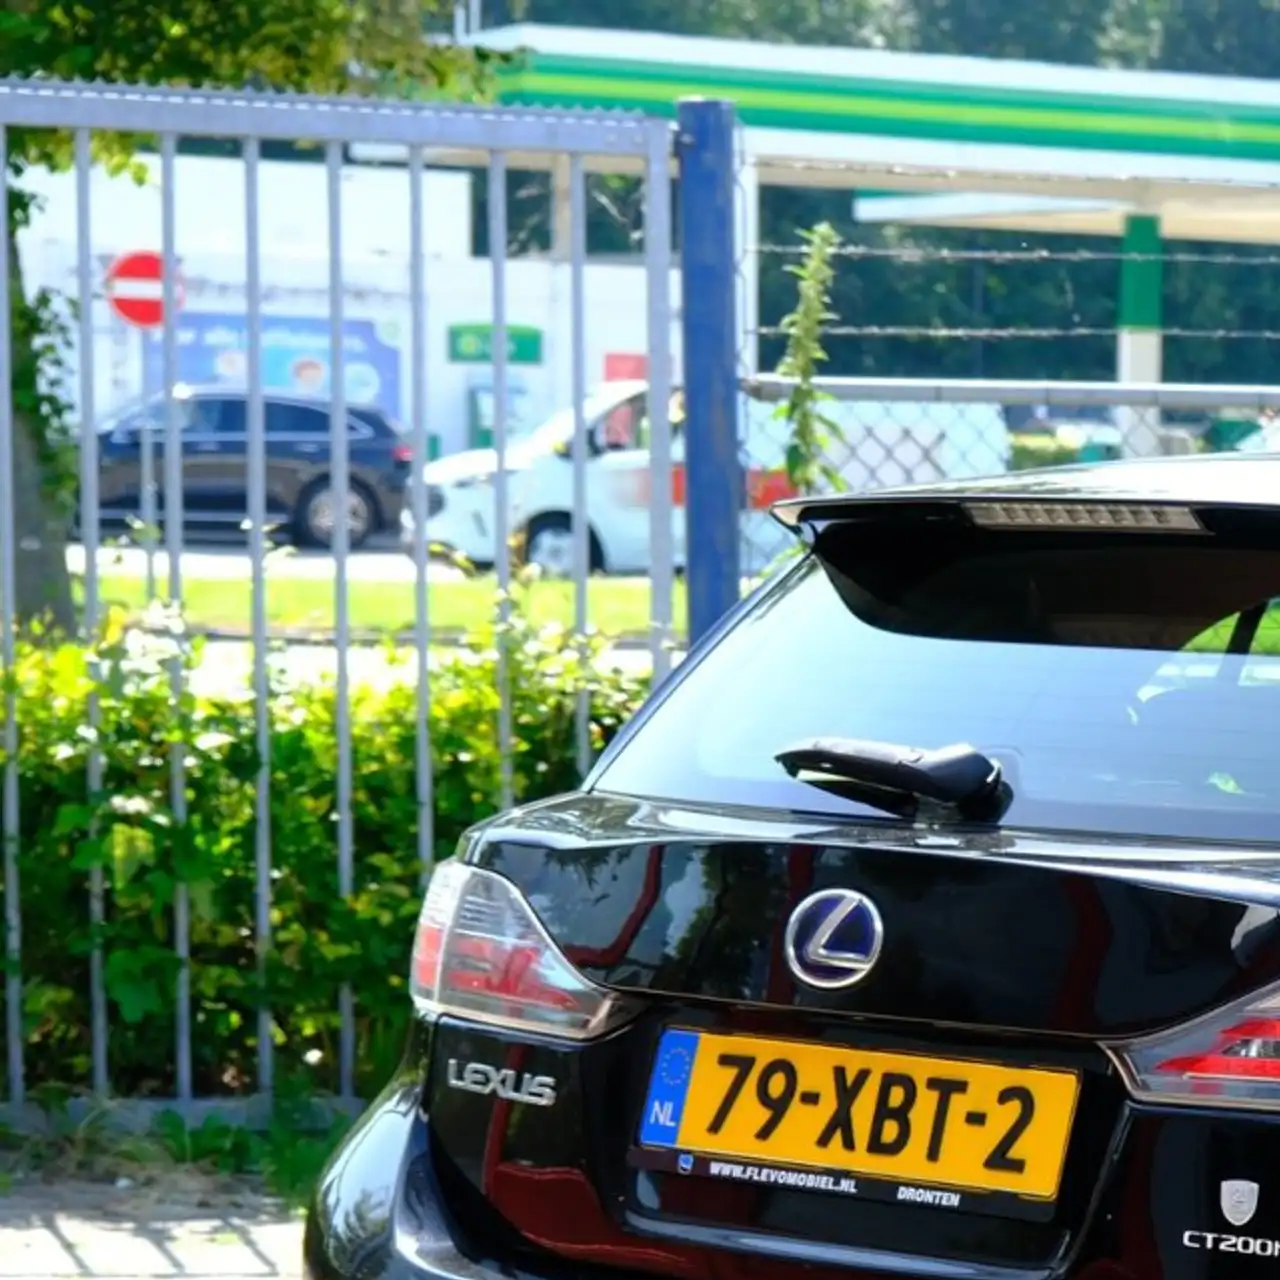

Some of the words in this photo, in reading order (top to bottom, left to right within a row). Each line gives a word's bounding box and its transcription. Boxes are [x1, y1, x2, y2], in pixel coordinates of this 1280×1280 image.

[447, 1058, 558, 1107] LEXUS
[650, 1100, 676, 1127] NL
[706, 1053, 1035, 1175] 79-XBT-2
[709, 1161, 858, 1194] WWW.FLEVOMOBIEL.NL
[897, 1185, 961, 1207] DRONTEN
